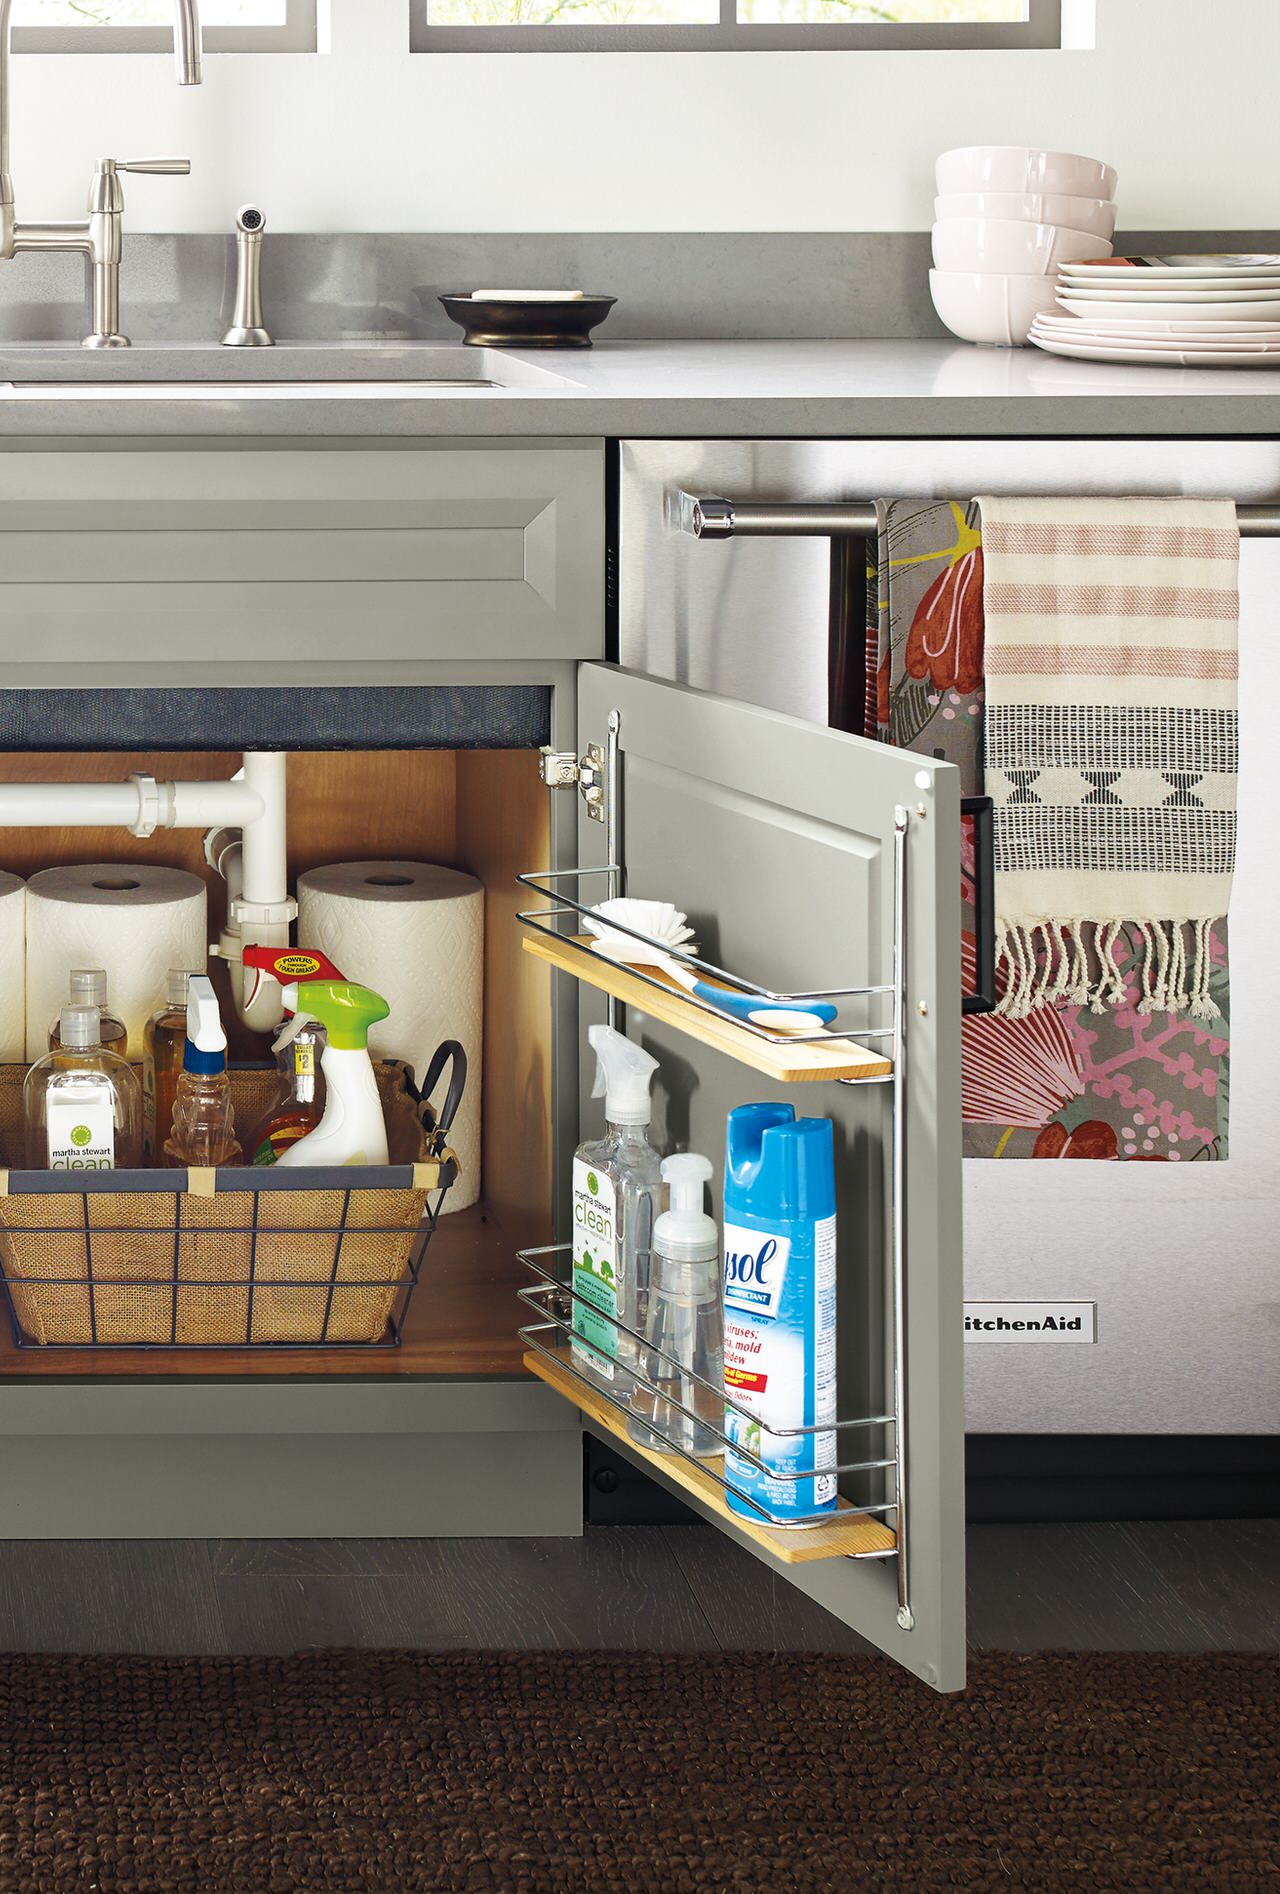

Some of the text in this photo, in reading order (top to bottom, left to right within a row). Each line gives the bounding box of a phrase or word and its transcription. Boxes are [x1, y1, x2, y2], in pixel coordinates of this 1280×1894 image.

[52, 1148, 111, 1157] martha stewart
[52, 1156, 111, 1170] clean
[575, 1202, 612, 1239] clean
[724, 1239, 777, 1284] sol
[963, 1316, 1082, 1331] itchenAid
[735, 1342, 762, 1354] mold
[724, 1351, 746, 1365] ldew
